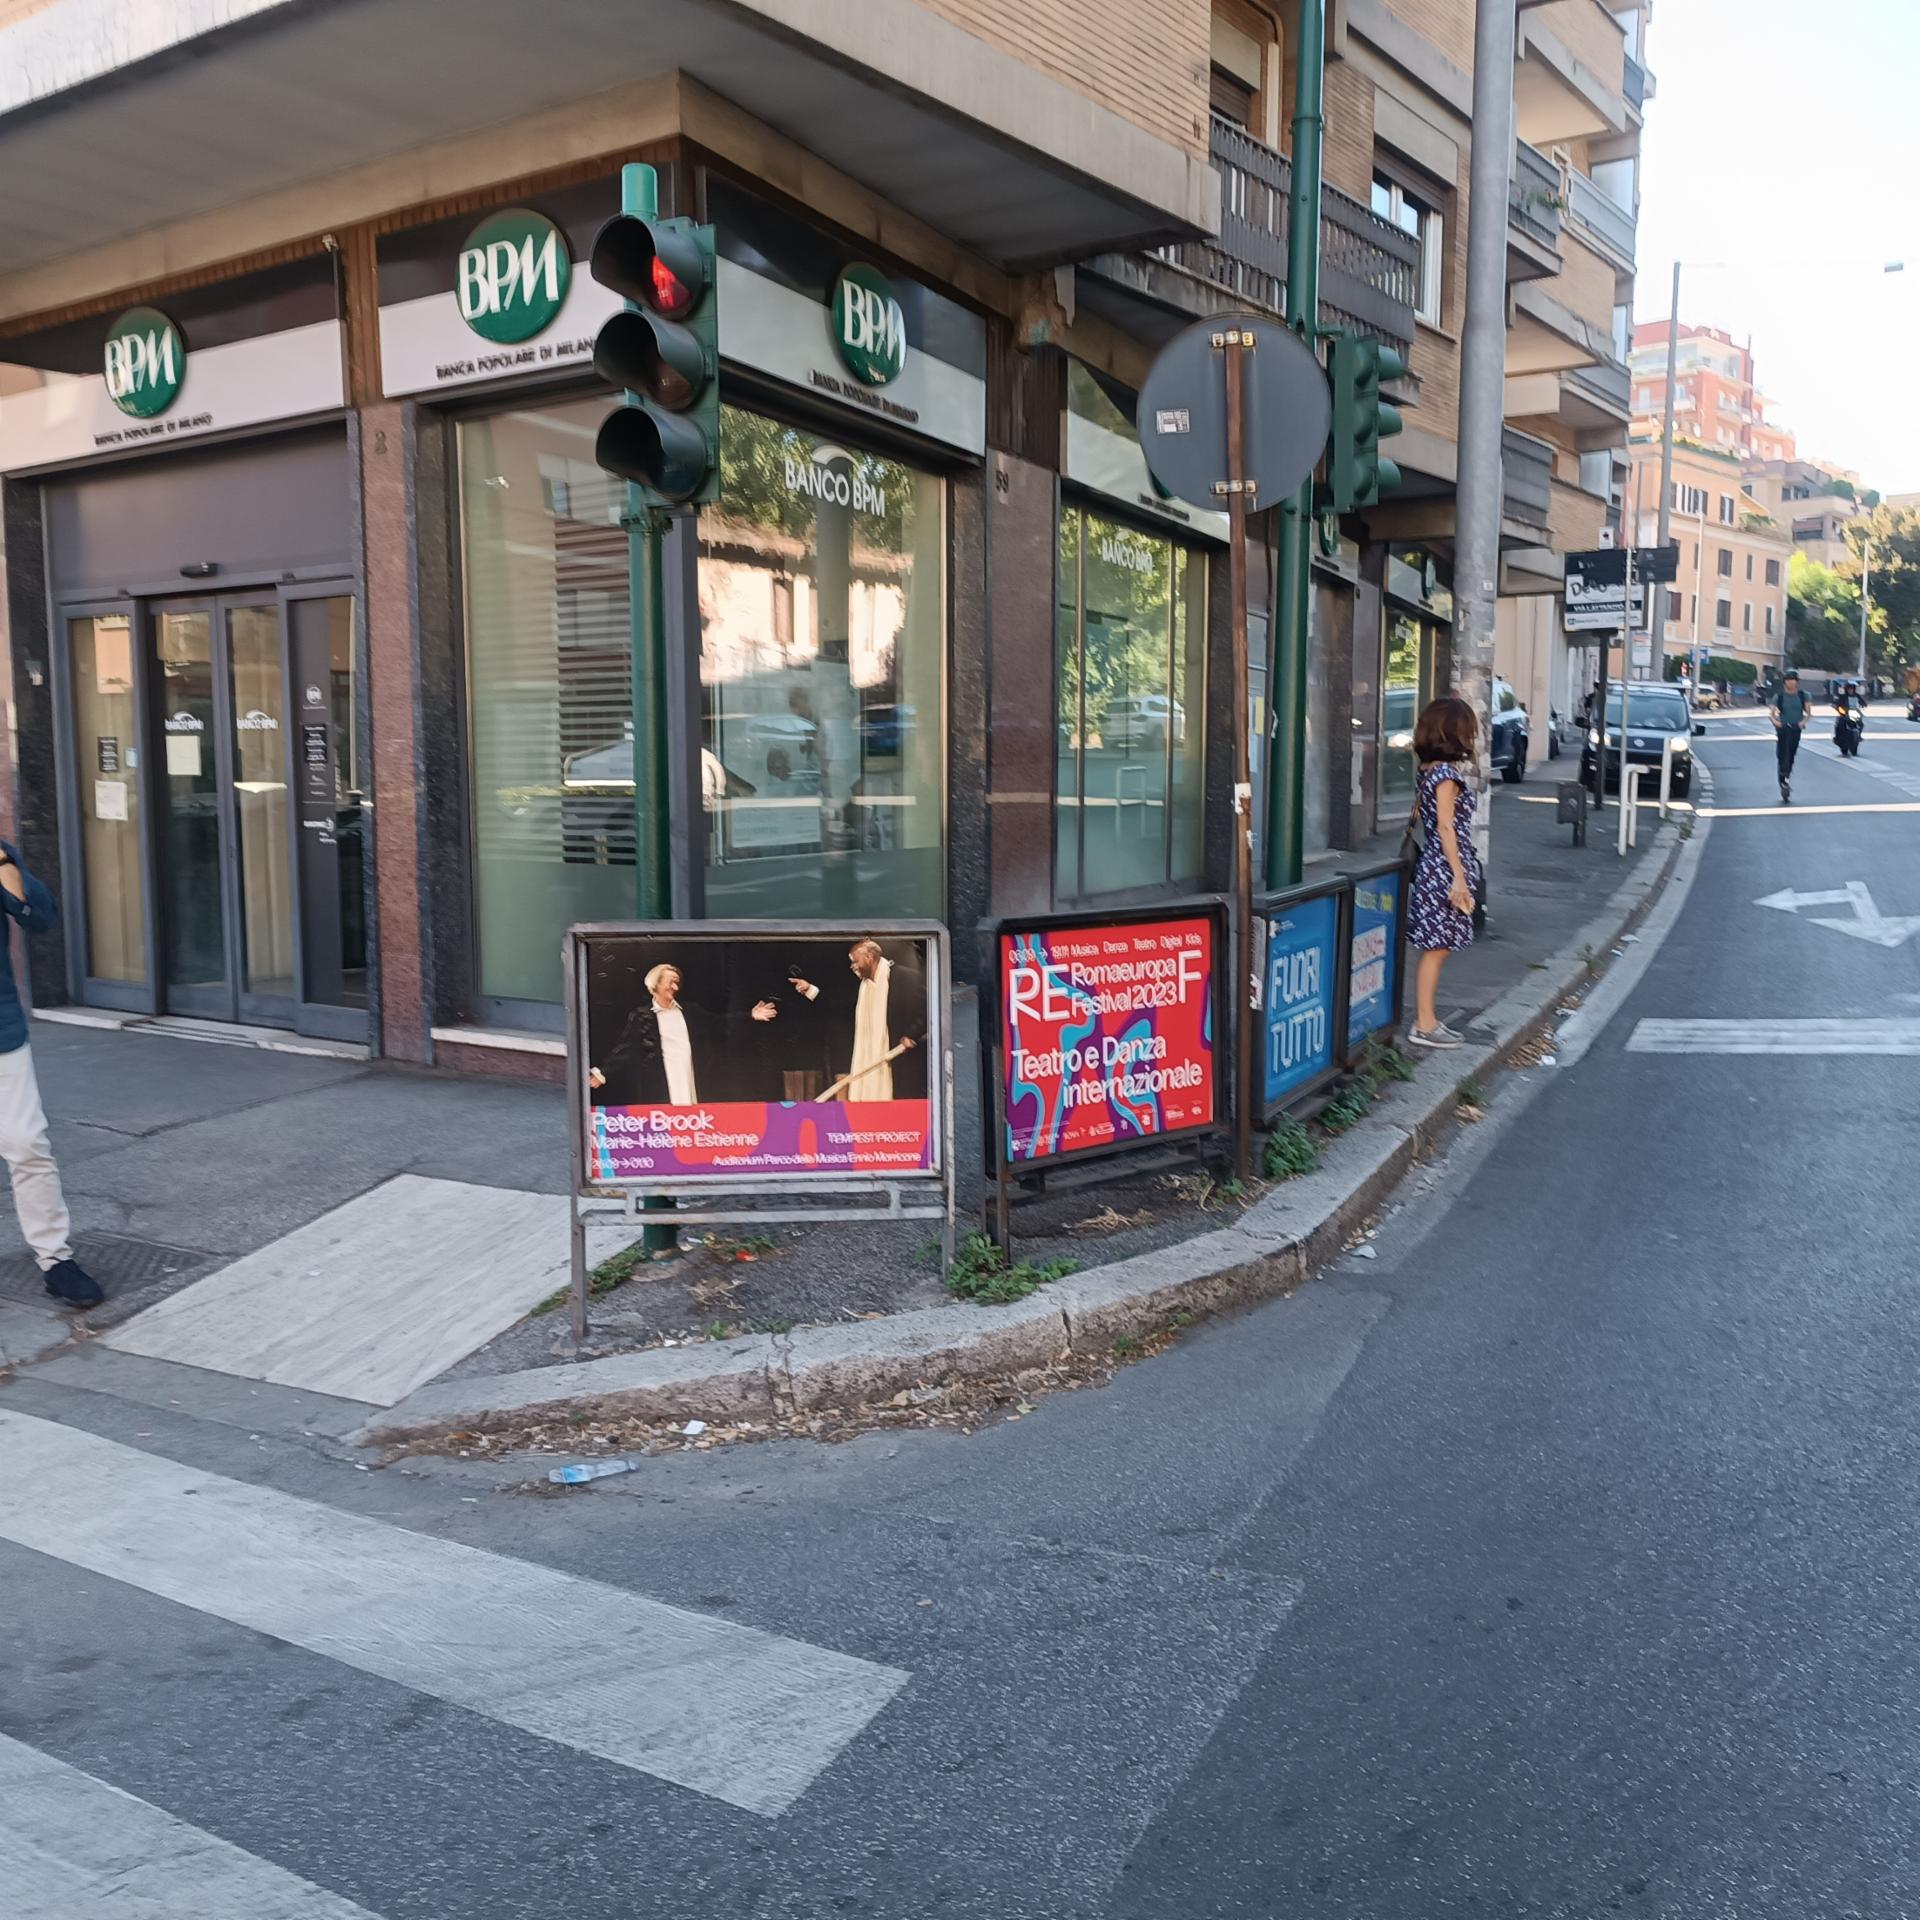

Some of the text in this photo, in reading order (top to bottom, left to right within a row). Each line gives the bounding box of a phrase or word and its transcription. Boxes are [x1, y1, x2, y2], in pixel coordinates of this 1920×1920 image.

[458, 229, 560, 321] BPM
[842, 278, 906, 372] BPM
[104, 326, 177, 400] BPM
[435, 360, 476, 381] BANCA
[555, 336, 594, 359] MILAN
[785, 457, 886, 519] BANCO BPM
[1102, 536, 1135, 570] BANCO
[1071, 943, 1099, 957] Musica
[1103, 940, 1129, 954] Danza
[1132, 937, 1157, 951] Teatro
[1160, 934, 1183, 951] Digital
[1185, 932, 1203, 946] Kids
[1009, 963, 1071, 1026] RE
[1071, 957, 1177, 988] Romaeuropa
[1178, 949, 1203, 1004] F
[1071, 980, 1177, 1018] Festival 2023
[1011, 1035, 1167, 1082] Teatro e Danza
[1270, 1005, 1325, 1074] TUTTO
[1063, 1057, 1203, 1108] internazionale
[592, 1109, 715, 1133] Peter Brook
[694, 1131, 760, 1148] Estienne
[826, 1130, 921, 1144] TEMPEST PROJECT
[712, 1153, 764, 1167] Auditorium
[815, 1151, 848, 1164] Musica
[848, 1150, 875, 1163] Ennio
[876, 1150, 921, 1163] Morricone
